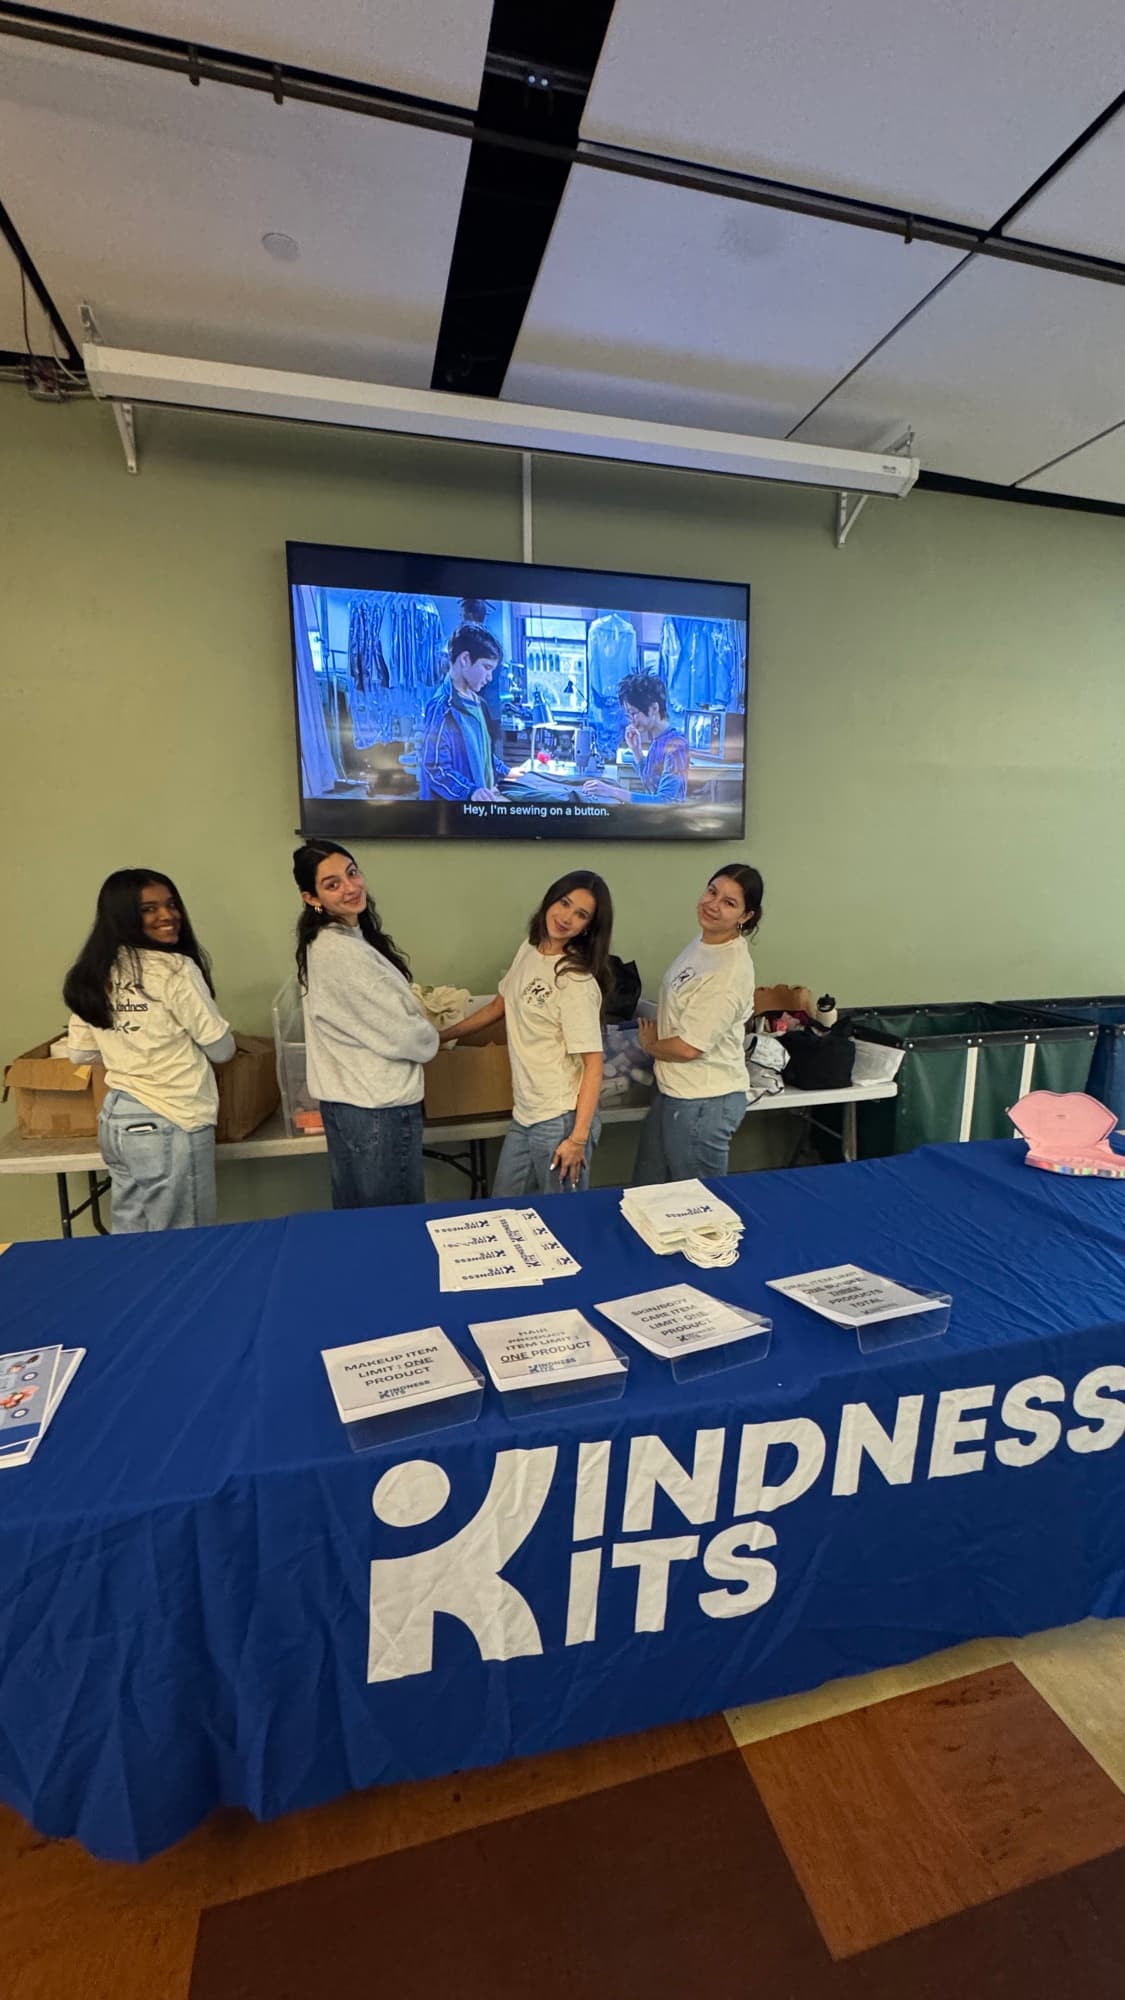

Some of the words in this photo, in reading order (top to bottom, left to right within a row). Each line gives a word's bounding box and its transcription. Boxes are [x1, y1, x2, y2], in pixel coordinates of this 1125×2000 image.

[463, 804, 487, 816] Hey,
[491, 804, 507, 815] I'm
[510, 805, 547, 817] sewing
[550, 807, 563, 815] on
[566, 807, 571, 815] a
[574, 806, 610, 816] button.
[641, 1312, 670, 1322] CARE
[671, 1305, 697, 1315] ITEM
[649, 1318, 678, 1329] LIMIT
[661, 1318, 712, 1336] PRODUCT
[500, 1352, 530, 1363] ONE
[531, 1341, 591, 1357] PRODUCT
[505, 1342, 538, 1351] ITEM
[540, 1336, 571, 1345] LIMIT
[344, 1354, 403, 1371] MAKEUP
[406, 1346, 438, 1358] ITEM
[358, 1364, 393, 1378] LIMIT
[404, 1357, 434, 1368] ONE
[365, 1367, 431, 1386] PRODUCT
